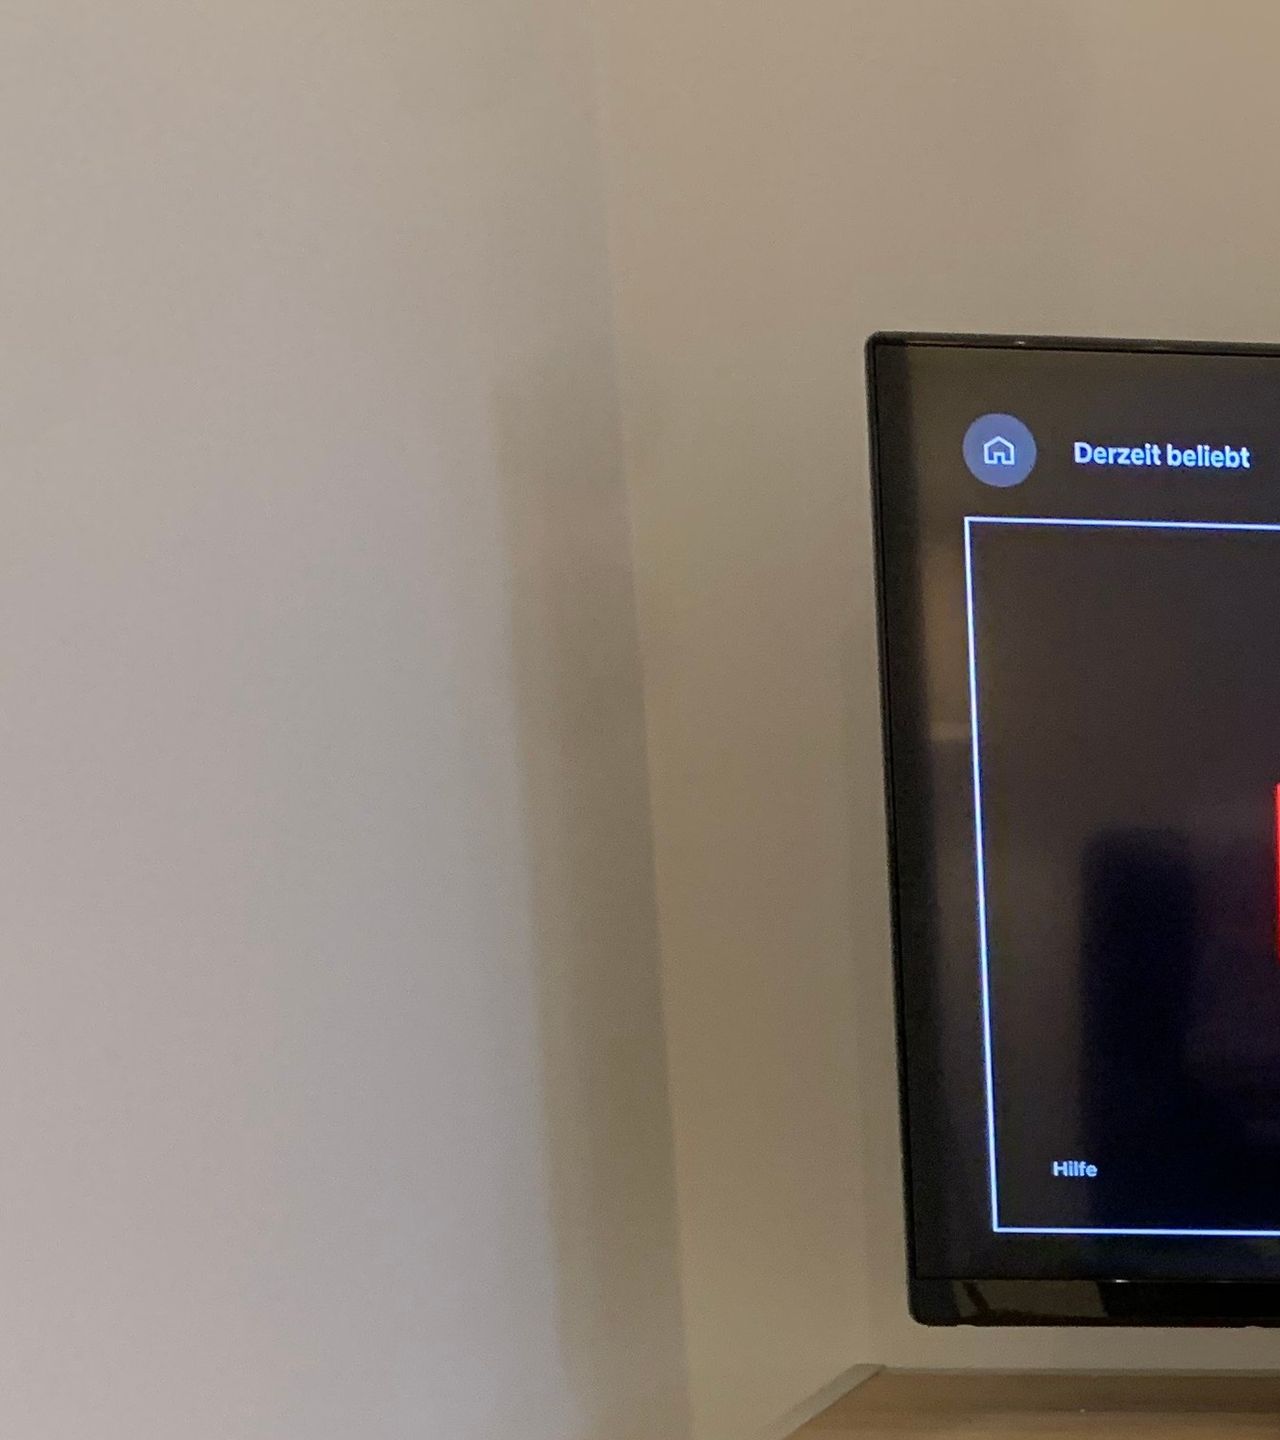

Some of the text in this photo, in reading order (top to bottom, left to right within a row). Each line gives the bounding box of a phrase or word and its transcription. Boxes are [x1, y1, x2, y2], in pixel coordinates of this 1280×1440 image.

[1074, 441, 1251, 469] Derzeit beliebt
[1052, 1160, 1098, 1177] Hilfe
